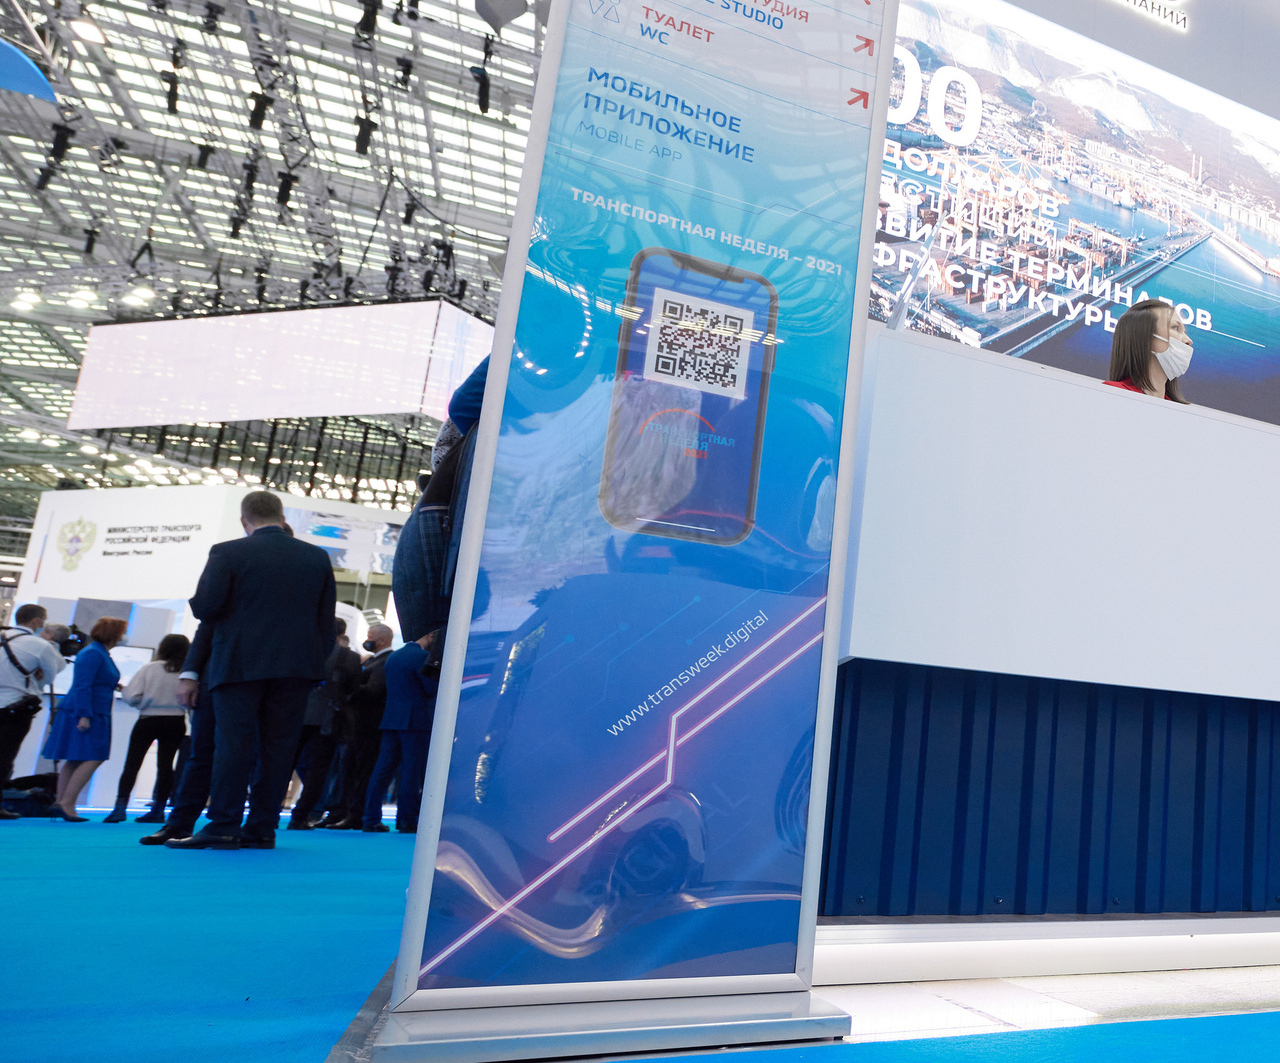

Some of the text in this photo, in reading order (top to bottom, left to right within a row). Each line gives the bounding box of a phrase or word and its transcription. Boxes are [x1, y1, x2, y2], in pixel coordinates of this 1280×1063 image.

[639, 23, 670, 46] WC
[641, 5, 716, 43] ТУАЛЕТ
[583, 92, 755, 163] ПРИЛОЖЕНИЕ
[587, 66, 742, 134] МОБИЛЬНОЕ
[579, 120, 683, 162] MOBILE APP
[571, 187, 716, 240] ТРАНСПОРТНАЯ
[720, 231, 789, 261] НЕДЕЛЯ
[806, 255, 842, 276] 2021
[684, 447, 708, 460] 2021
[606, 609, 769, 737] www.transweek.digital
